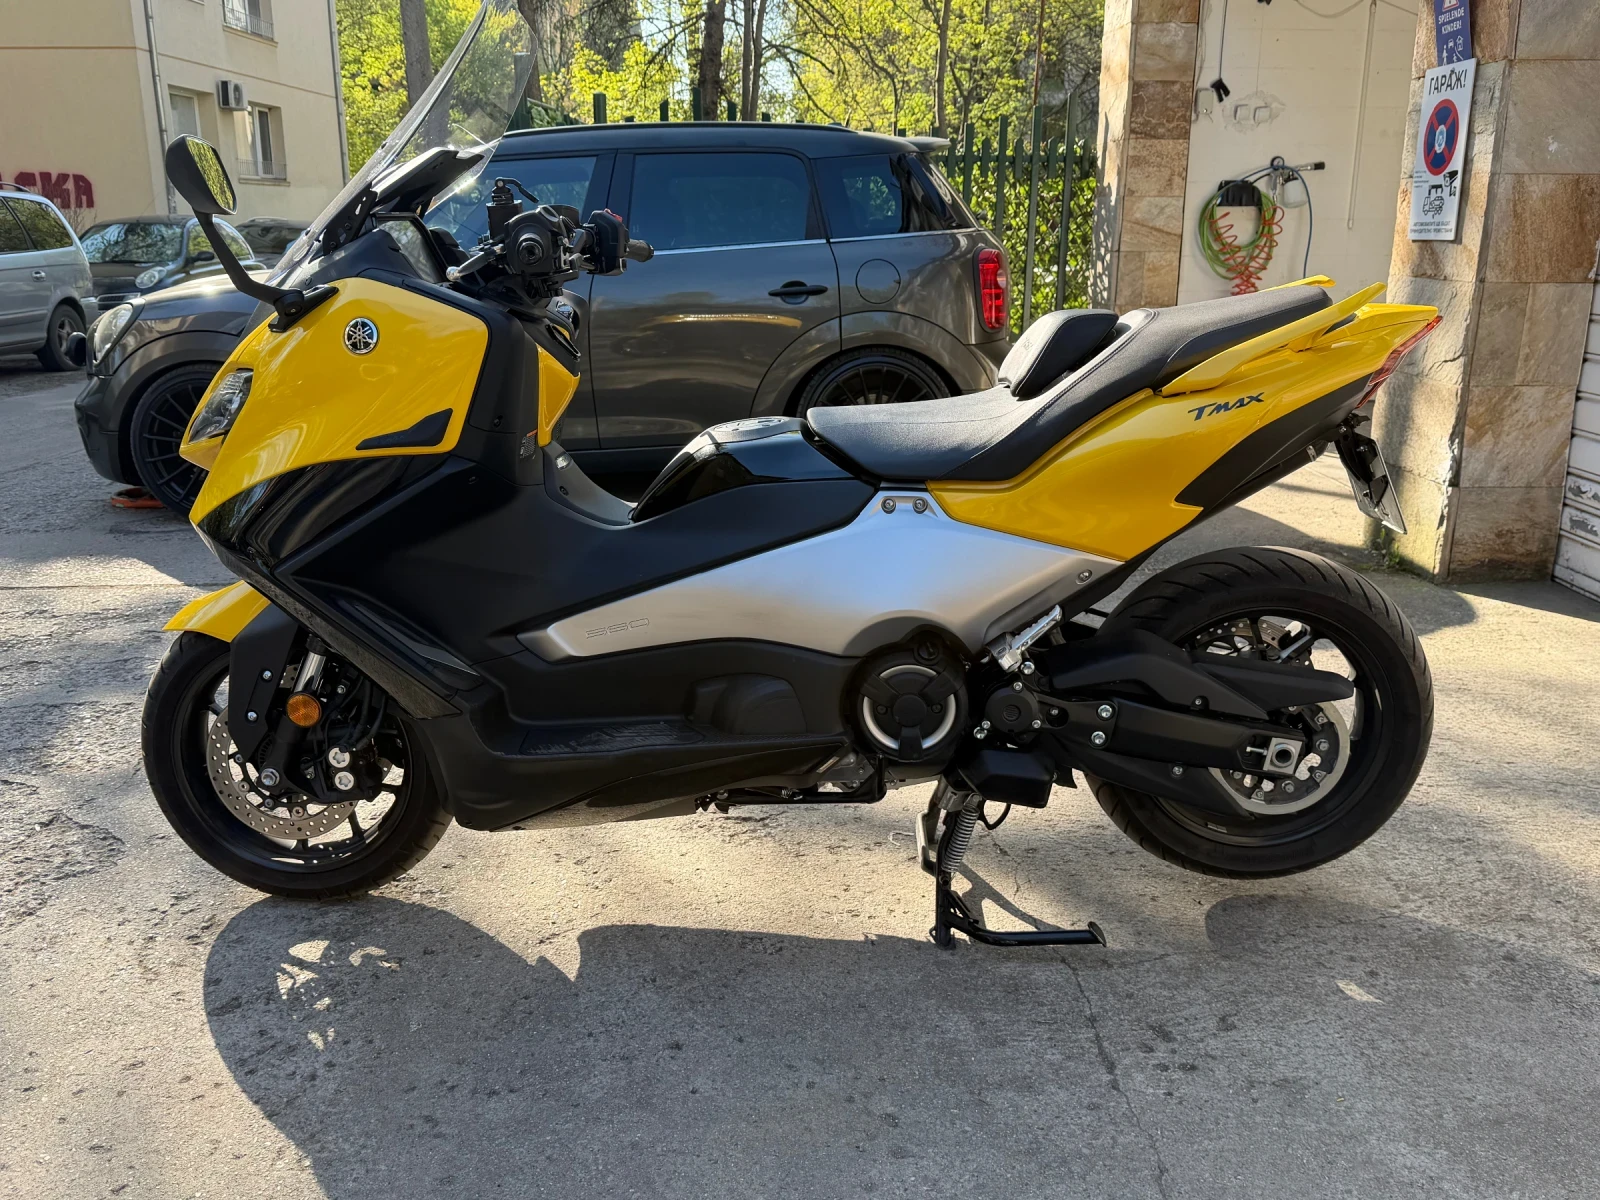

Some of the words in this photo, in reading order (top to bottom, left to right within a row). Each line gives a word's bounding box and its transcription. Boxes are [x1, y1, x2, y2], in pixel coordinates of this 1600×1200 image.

[1438, 7, 1465, 25] SPIELENDE
[1428, 68, 1468, 96] ГАРАЖ!
[1187, 391, 1265, 421] TMAX
[585, 617, 650, 639] 560
